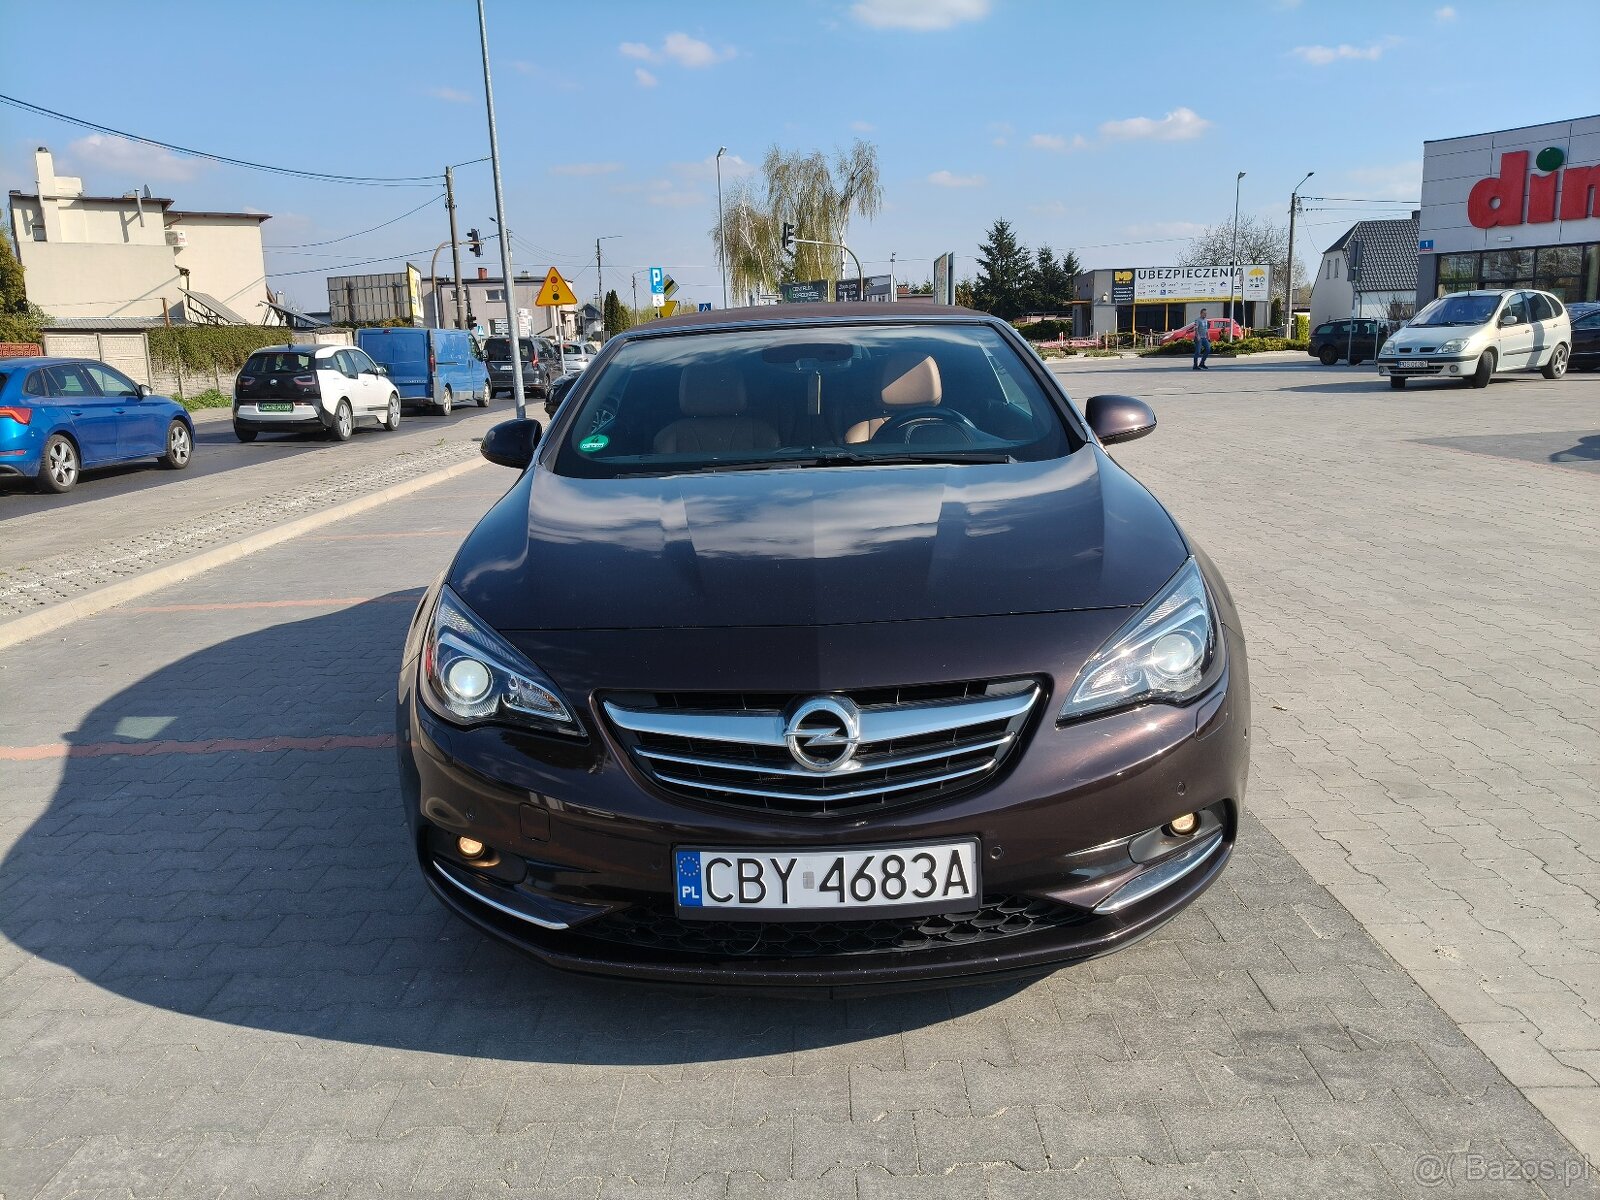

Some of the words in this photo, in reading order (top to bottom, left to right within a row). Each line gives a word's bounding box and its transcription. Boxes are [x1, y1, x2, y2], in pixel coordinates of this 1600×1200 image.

[652, 269, 661, 286] P
[1138, 267, 1244, 280] UBEZPIECZENIA
[705, 857, 798, 904] CBY
[818, 849, 970, 903] 4683A
[682, 886, 700, 899] PL
